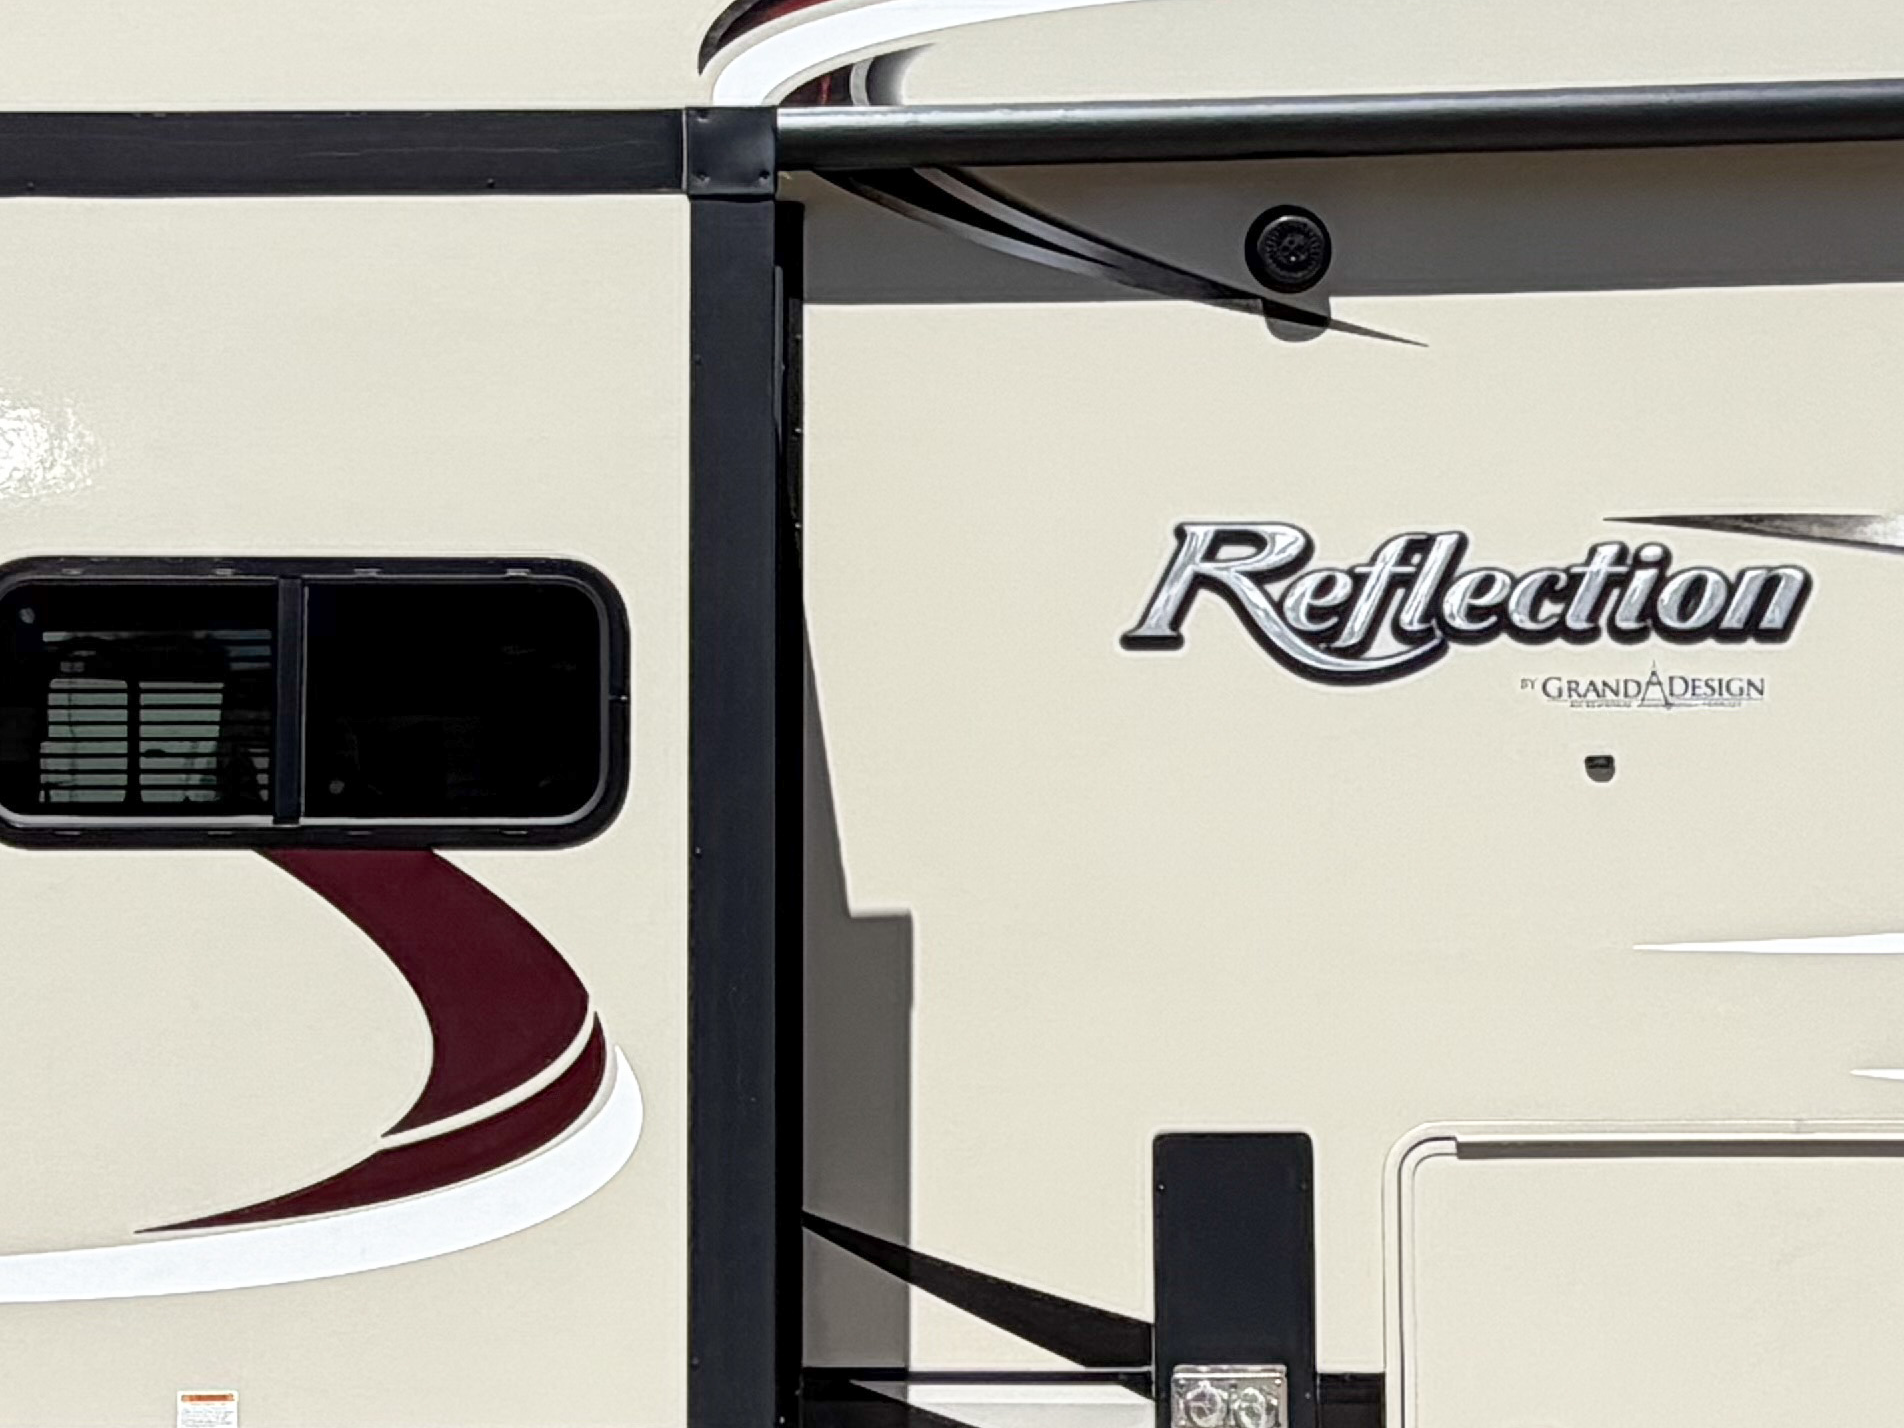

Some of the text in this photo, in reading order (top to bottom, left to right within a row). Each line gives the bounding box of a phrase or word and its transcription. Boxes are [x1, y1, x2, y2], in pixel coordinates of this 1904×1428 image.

[1120, 520, 1815, 688] Reflection
[1541, 676, 1642, 699] GRAND
[1668, 675, 1765, 699] DESIGN
